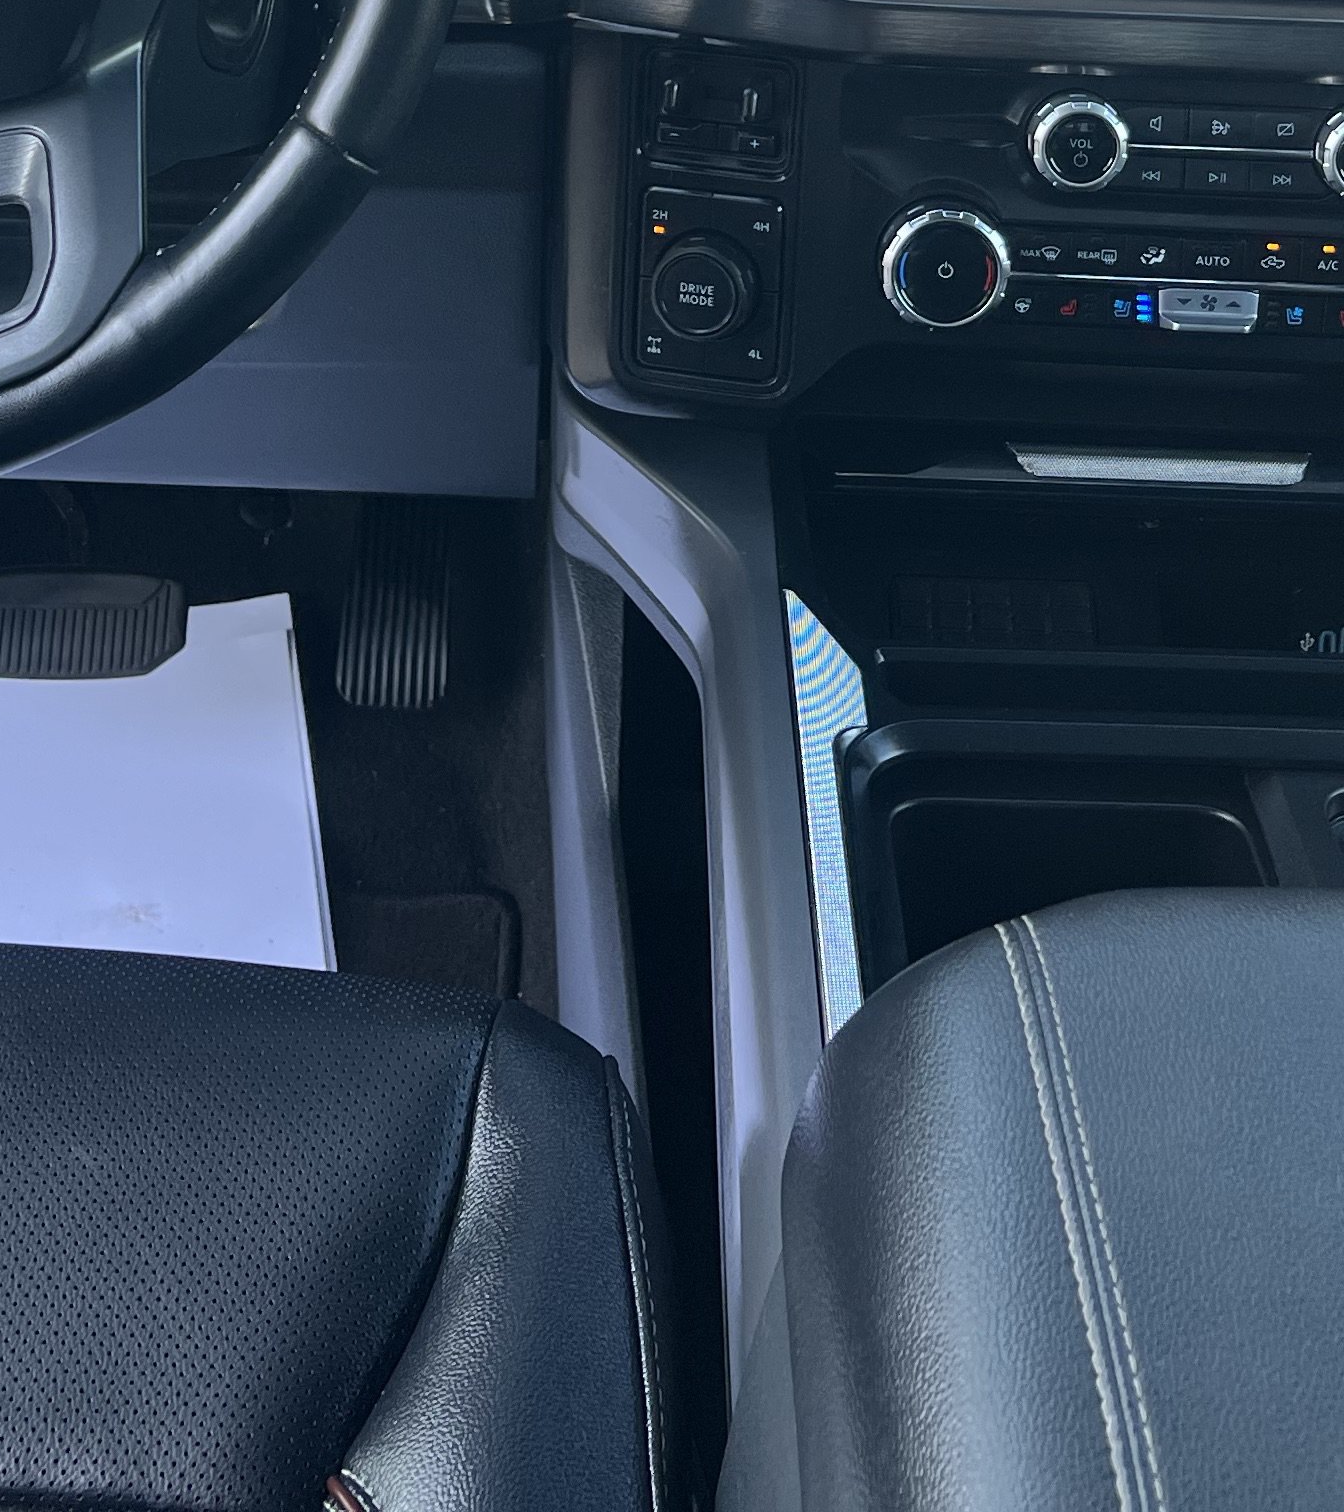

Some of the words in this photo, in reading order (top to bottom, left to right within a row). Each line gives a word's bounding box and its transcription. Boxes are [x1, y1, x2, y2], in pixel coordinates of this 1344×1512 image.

[1069, 138, 1094, 149] VOL
[652, 209, 669, 221] 2H
[752, 221, 770, 233] 4H
[1020, 248, 1042, 258] MAX
[1077, 249, 1100, 260] REAR
[1195, 255, 1231, 267] AUTO
[1317, 260, 1340, 272] A/C
[679, 281, 715, 296] DRIVE
[678, 293, 715, 307] MODE
[748, 348, 763, 360] 4L
